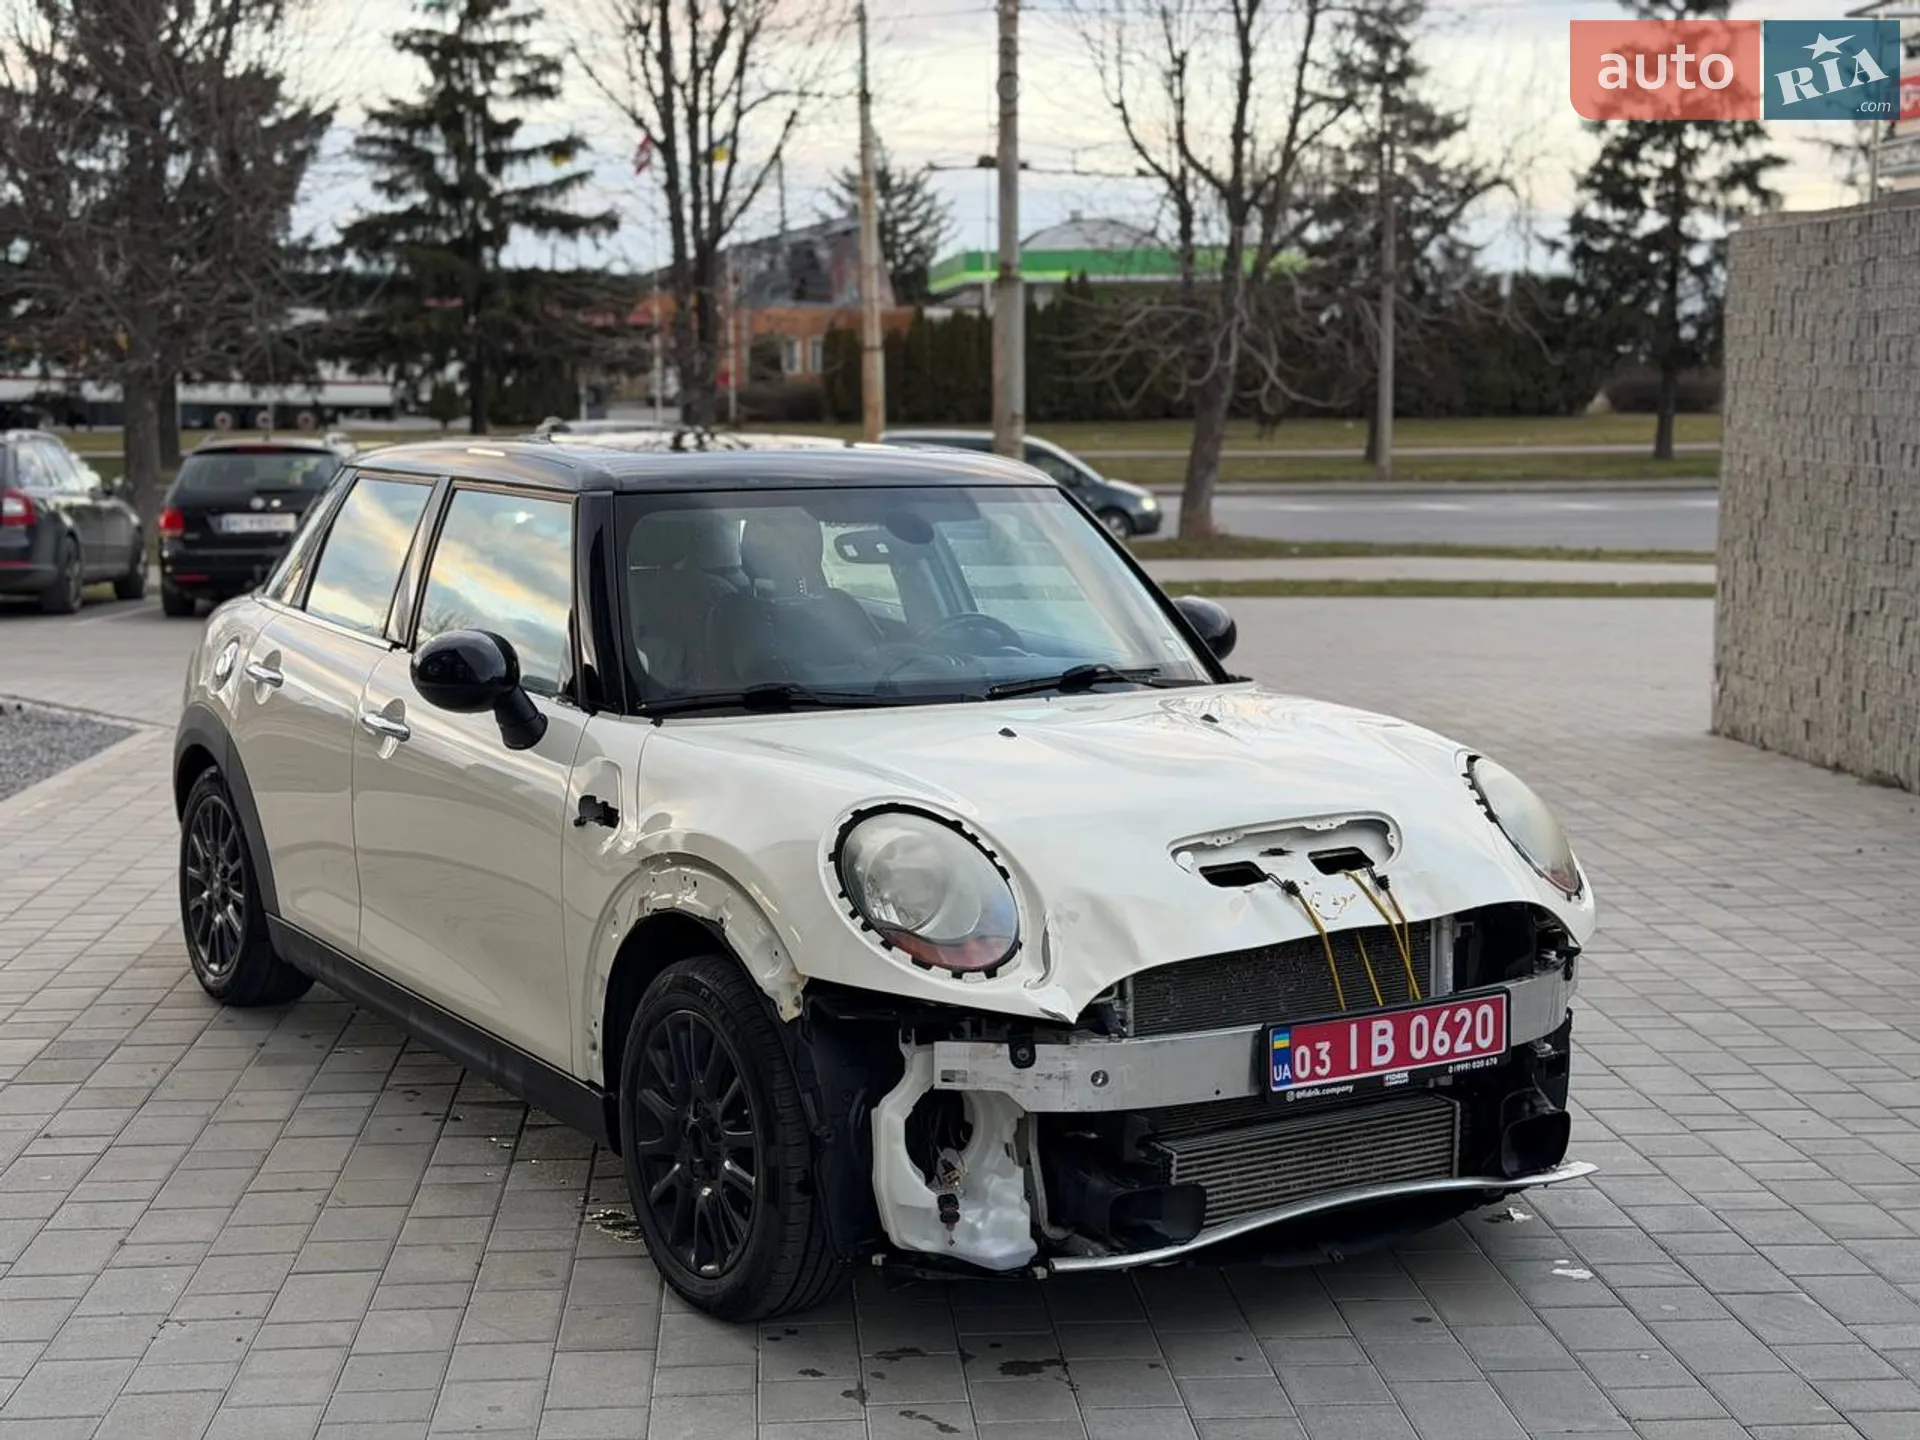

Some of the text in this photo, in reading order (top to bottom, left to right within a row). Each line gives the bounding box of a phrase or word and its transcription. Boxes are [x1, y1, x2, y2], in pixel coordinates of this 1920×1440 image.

[1295, 1041, 1331, 1079] 03
[1409, 1004, 1494, 1061] 0620
[1273, 1065, 1291, 1082] UA
